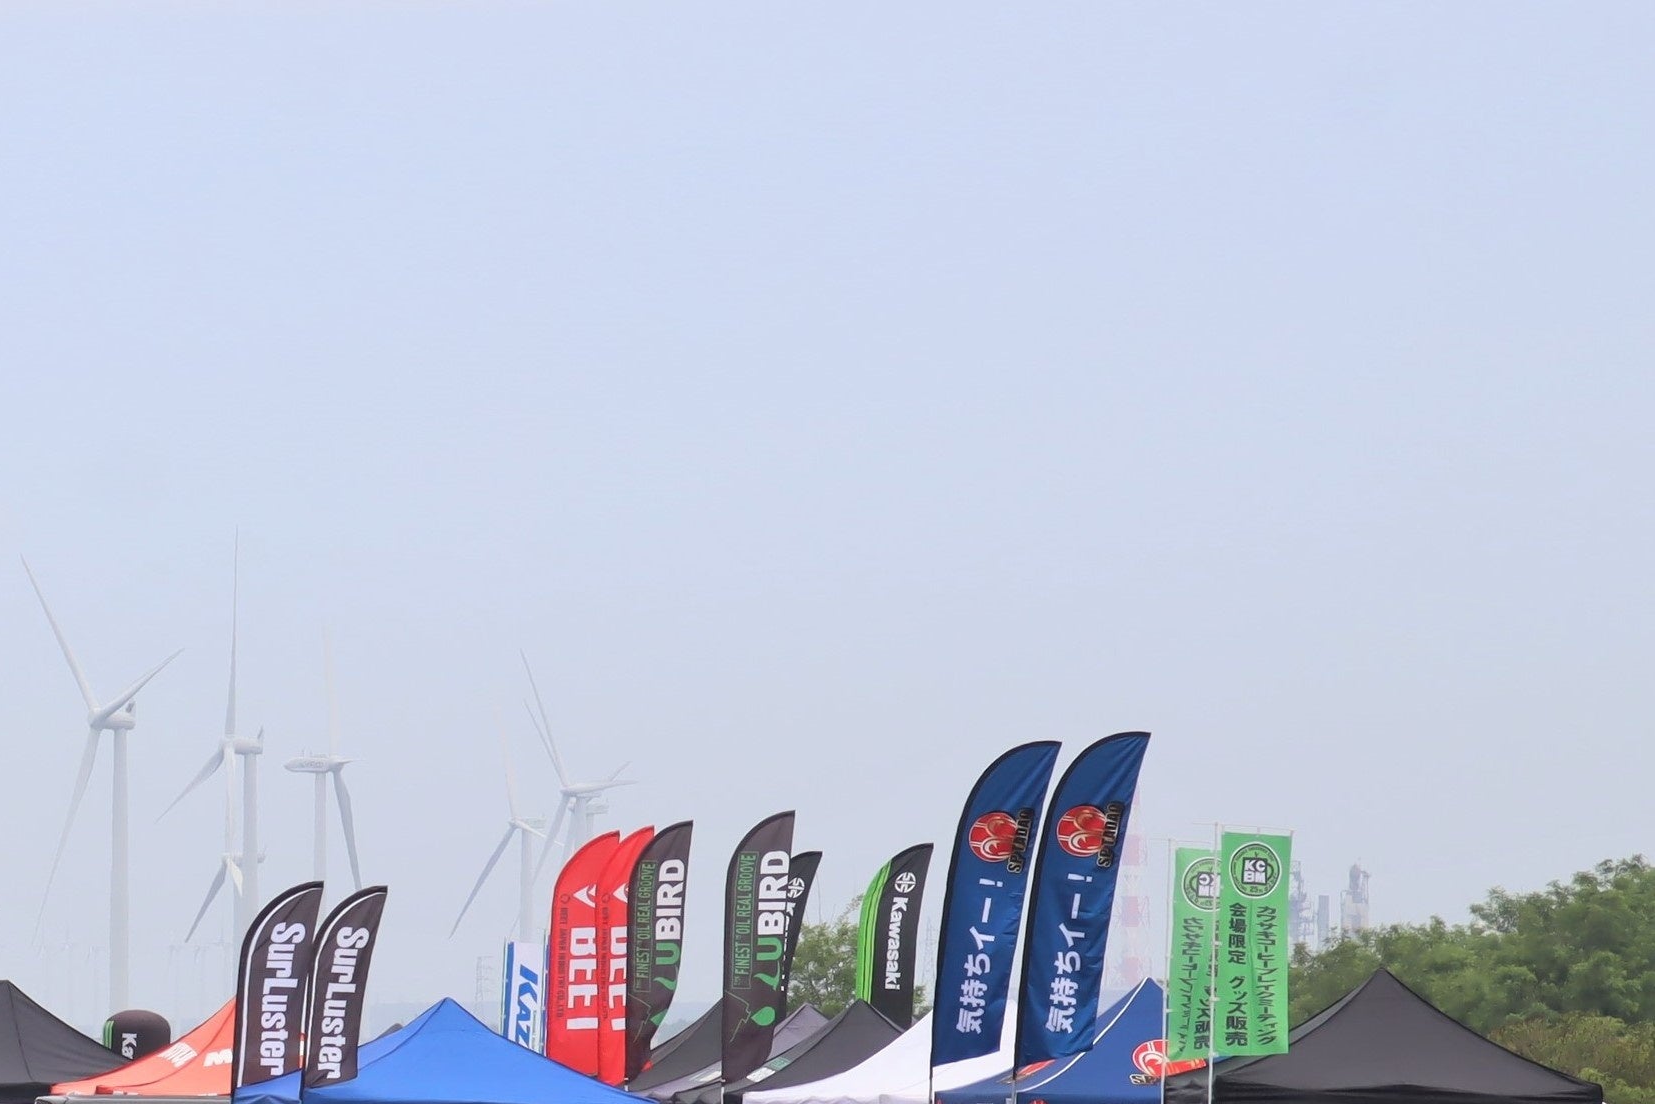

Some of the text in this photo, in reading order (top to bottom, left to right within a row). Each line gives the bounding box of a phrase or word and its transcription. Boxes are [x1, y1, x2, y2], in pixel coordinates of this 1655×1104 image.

[259, 921, 306, 1077] SurLuster
[317, 926, 370, 1079] SurLuster
[884, 897, 910, 991] Kawasaki
